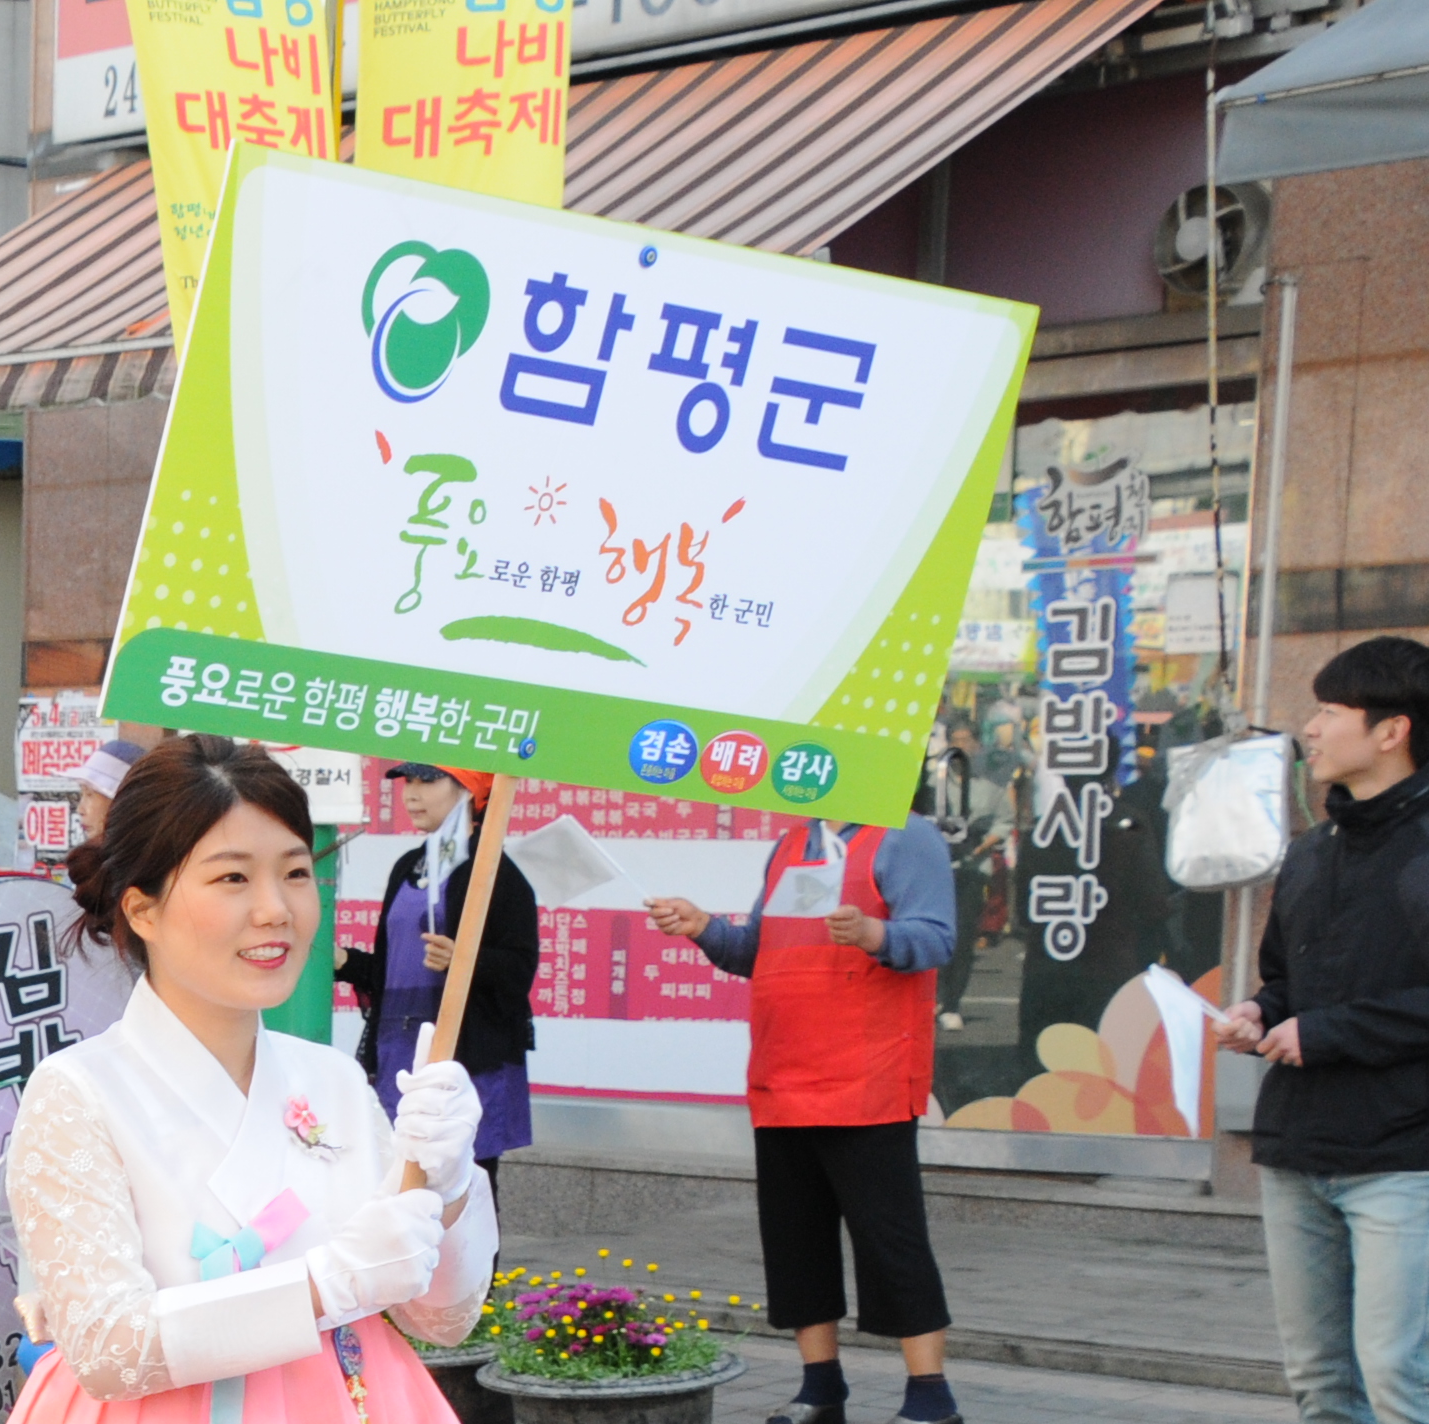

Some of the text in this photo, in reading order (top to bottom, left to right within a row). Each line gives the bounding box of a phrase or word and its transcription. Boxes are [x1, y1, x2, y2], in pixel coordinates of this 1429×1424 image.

[373, 23, 431, 37] FESTIVAL
[374, 8, 446, 25] BUTTERFLY
[225, 27, 321, 95] 나비
[456, 19, 564, 79] 나비
[175, 90, 328, 160] 대축제
[382, 88, 562, 158] 대축제
[498, 271, 877, 472] 함평군
[540, 565, 581, 597] 함평
[734, 598, 775, 629] 군민
[159, 655, 541, 755] 풍요로운 함평 행복한 군민
[286, 768, 350, 786] 경찰서
[639, 729, 691, 766] 겸손
[709, 740, 763, 776] 배려
[780, 750, 834, 786] 감사
[1034, 599, 1111, 960] 김밥사랑
